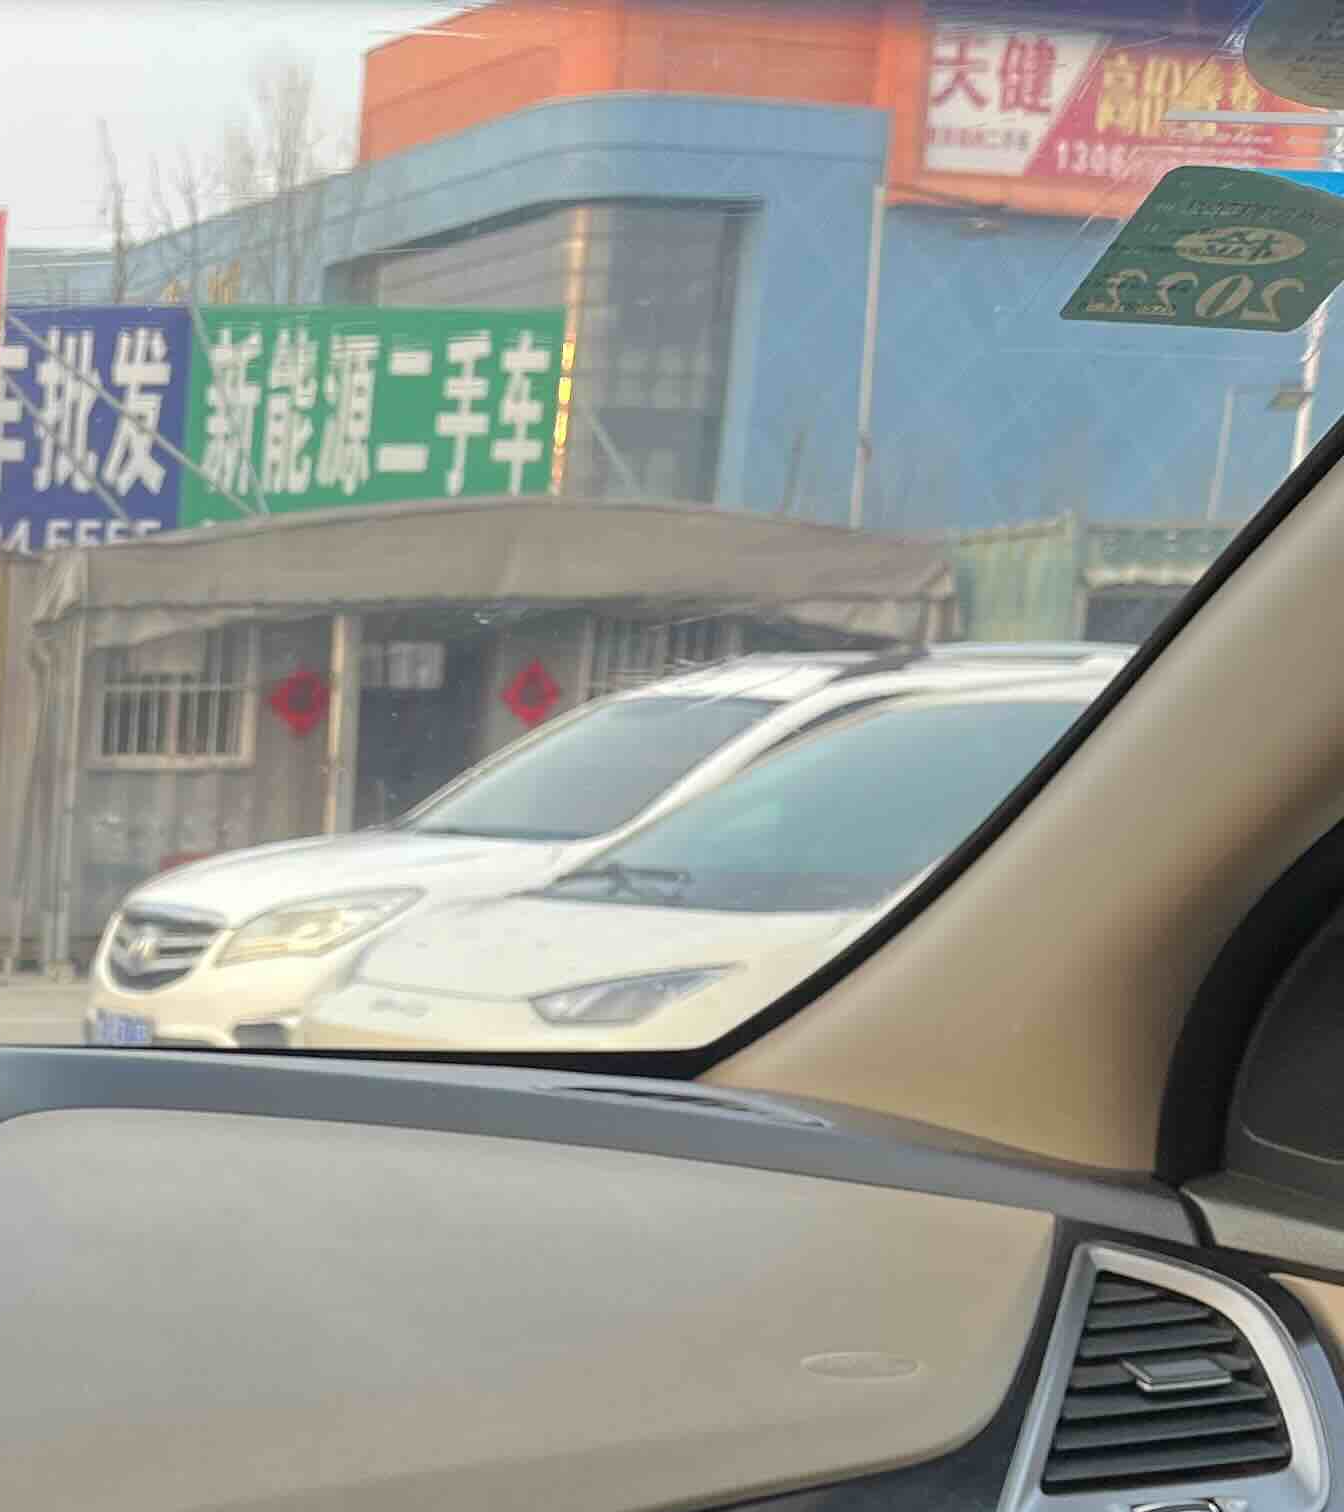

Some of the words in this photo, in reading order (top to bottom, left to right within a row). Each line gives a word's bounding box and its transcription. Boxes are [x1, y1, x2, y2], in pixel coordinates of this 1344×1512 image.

[203, 325, 551, 496] 新能源二手车
